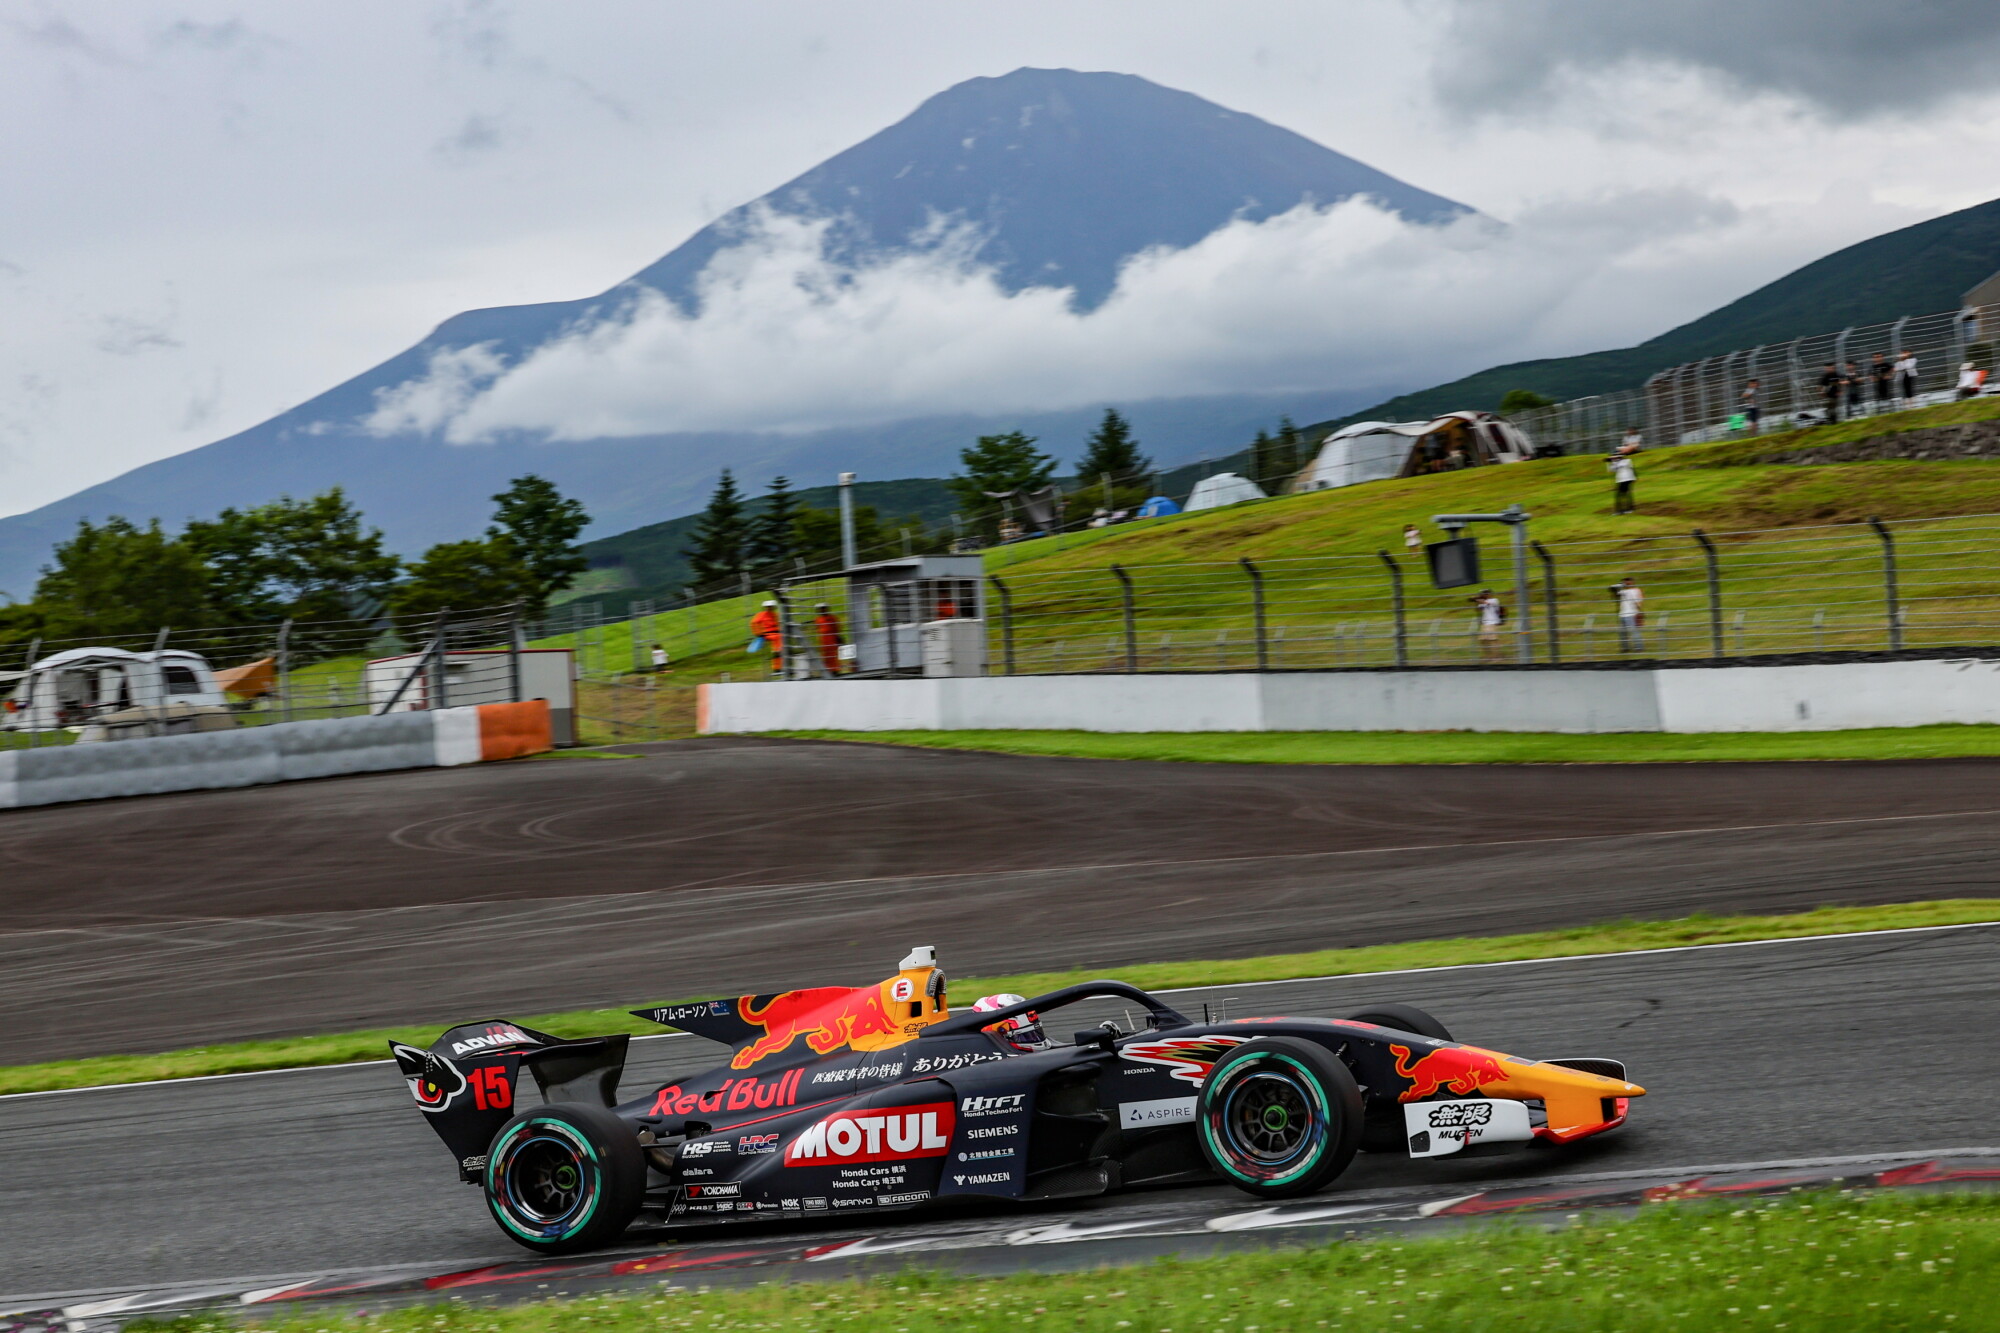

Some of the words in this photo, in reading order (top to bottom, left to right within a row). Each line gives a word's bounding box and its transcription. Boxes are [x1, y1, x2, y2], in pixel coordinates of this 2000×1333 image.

[896, 982, 908, 997] E
[452, 1031, 527, 1055] ADVAN
[912, 1052, 1018, 1073] ありがとう
[1124, 1067, 1156, 1075] HONDA
[466, 1065, 512, 1111] 15
[648, 1079, 734, 1117] Red
[727, 1068, 805, 1111] Bull
[961, 1094, 1026, 1111] HTFT
[1147, 1107, 1191, 1119] ASPIRE
[1428, 1102, 1493, 1128] 無限
[791, 1111, 947, 1159] MOTUL
[967, 1124, 1019, 1139] SIEMENS
[682, 1142, 714, 1155] HRS
[841, 1169, 868, 1178] Honda
[870, 1167, 890, 1176] Cars
[891, 1165, 907, 1174] 横浜
[832, 1179, 859, 1189] Honda
[860, 1178, 880, 1187] Cars
[967, 1172, 1011, 1185] YAMAZEN
[702, 1185, 739, 1195] YOKOHAMA
[781, 1198, 800, 1207] NGK
[839, 1198, 873, 1207] SANYO
[892, 1193, 929, 1202] FACOM
